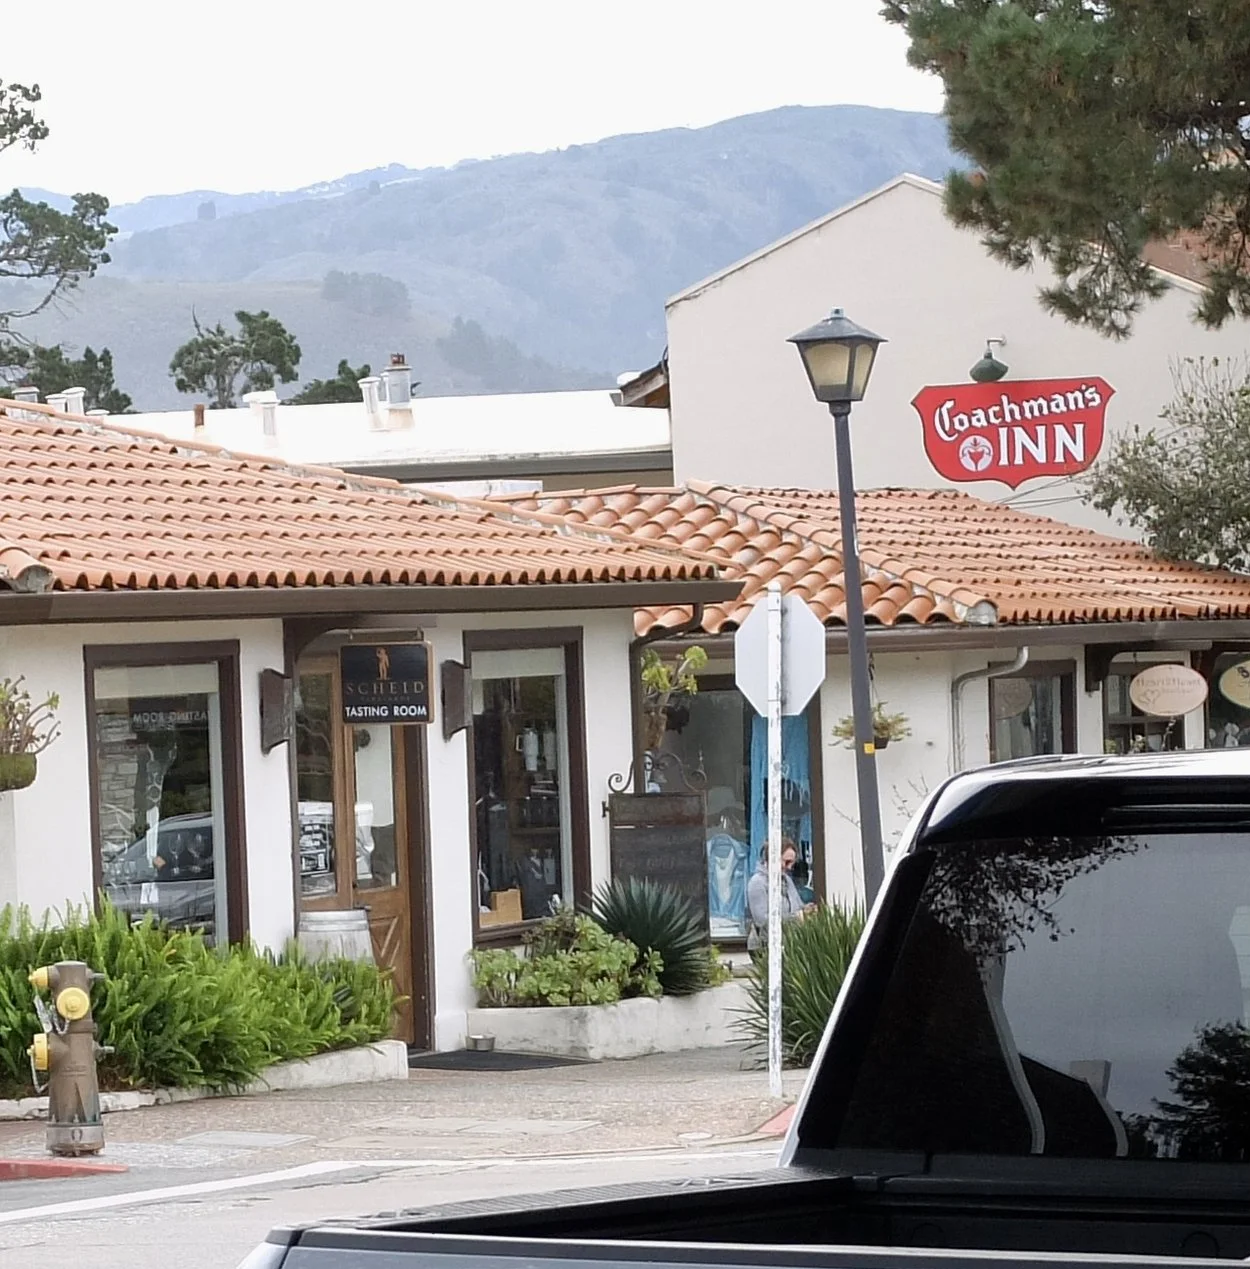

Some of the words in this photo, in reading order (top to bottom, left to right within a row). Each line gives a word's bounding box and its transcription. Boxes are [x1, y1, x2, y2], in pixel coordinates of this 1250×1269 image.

[934, 384, 1101, 442] Coachman's
[998, 423, 1085, 466] INN
[346, 682, 424, 695] SCHEID
[345, 706, 388, 717] TASTING
[393, 705, 427, 716] ROOM
